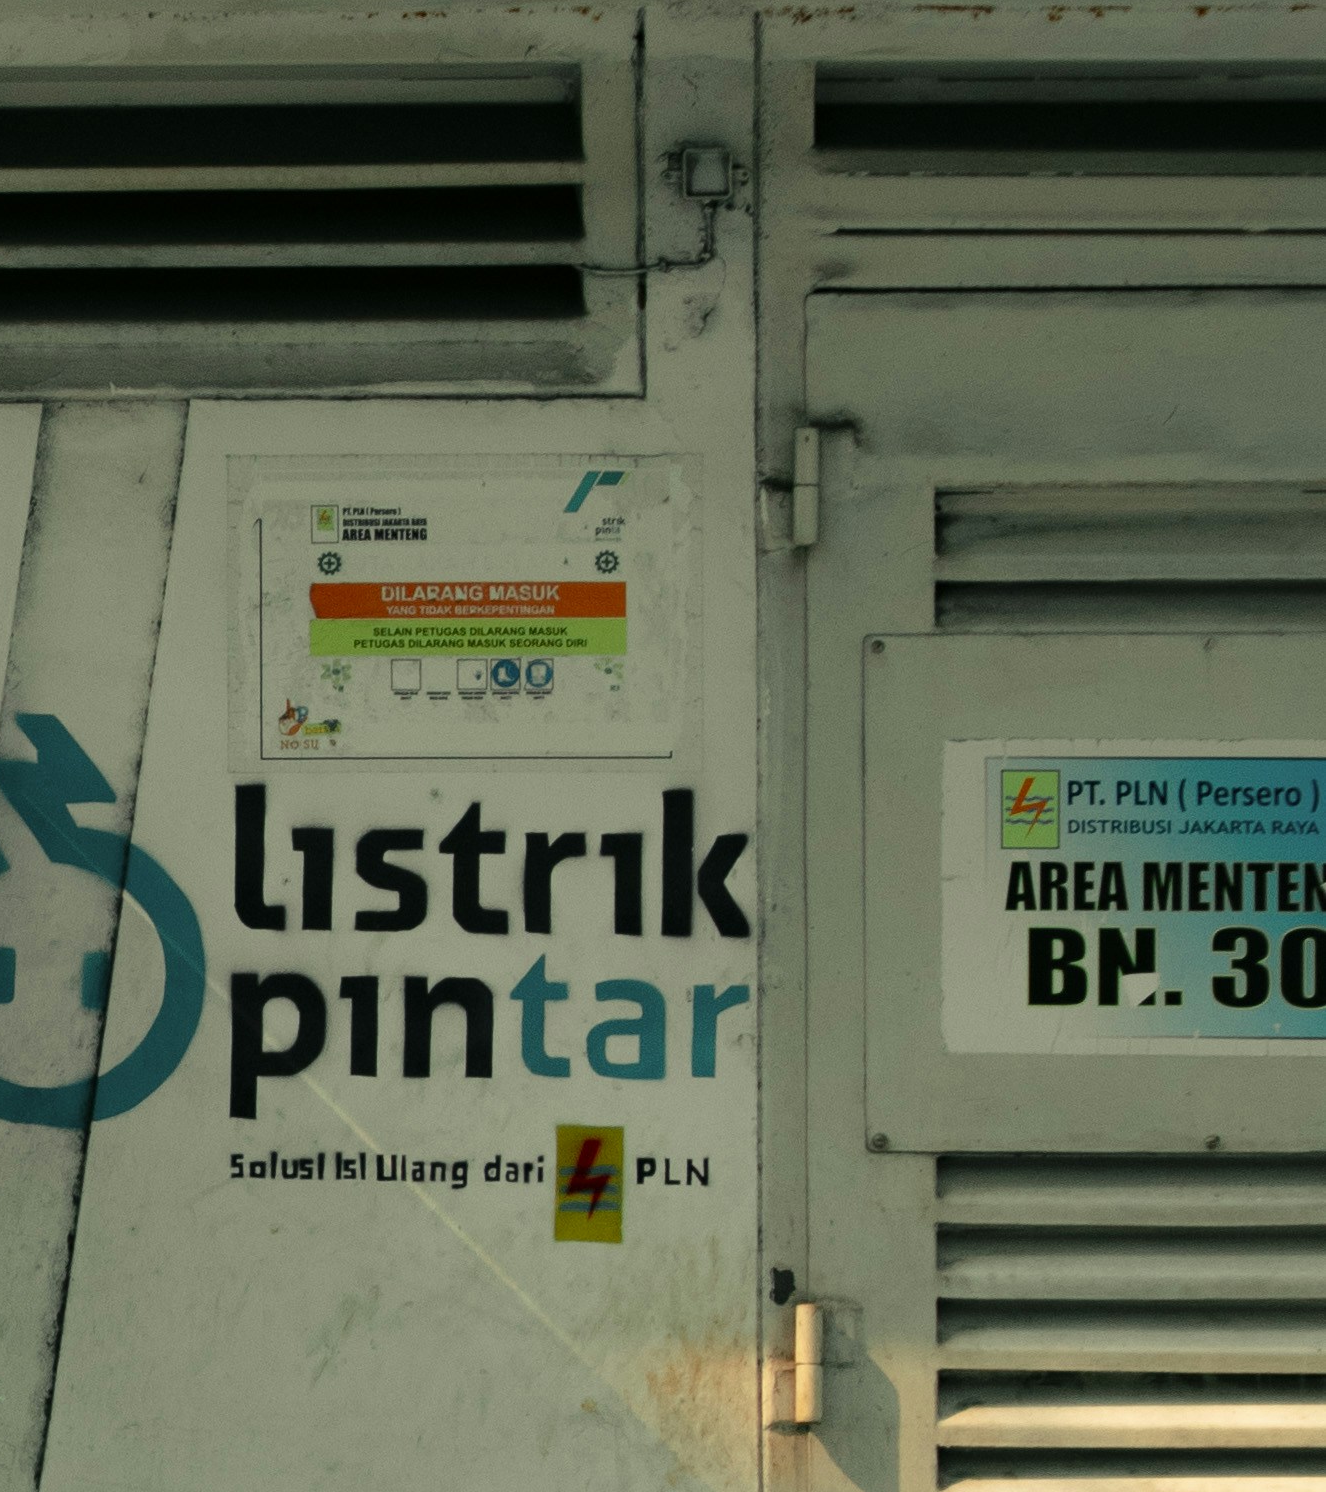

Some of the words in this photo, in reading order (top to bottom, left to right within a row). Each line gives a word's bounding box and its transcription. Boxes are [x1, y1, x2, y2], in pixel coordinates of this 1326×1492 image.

[342, 528, 372, 541] AREA
[374, 528, 428, 541] MENTENG
[381, 585, 484, 602] DILARANG
[488, 584, 560, 601] MASUK
[386, 605, 417, 615] YANG
[419, 605, 452, 615] TIDAK
[454, 604, 555, 615] BERKEPENTINGAN
[373, 627, 412, 637] SELAIN
[415, 627, 466, 637] PETUGAS
[469, 626, 526, 636] DILARANG
[528, 626, 568, 636] MASUK
[353, 639, 405, 649] PETUGAS
[408, 638, 464, 648] DILARANG
[467, 638, 507, 648] MASUK
[509, 638, 564, 648] SEORANG
[566, 638, 588, 648] DIRI
[1067, 780, 1106, 806] PT.
[1116, 780, 1169, 806] PLN
[1196, 780, 1303, 807] Persero
[1067, 819, 1172, 835] DISTRIBUSI
[1178, 819, 1266, 835] JAKARTA
[1272, 819, 1320, 835] RAYA
[1005, 861, 1130, 912] AREA
[1027, 926, 1183, 1007] BN.
[1211, 925, 1326, 1010] 30
[228, 955, 750, 1121] pintar
[376, 1153, 469, 1190] Ulang
[483, 1154, 546, 1184] dari
[636, 1156, 710, 1187] PLN
